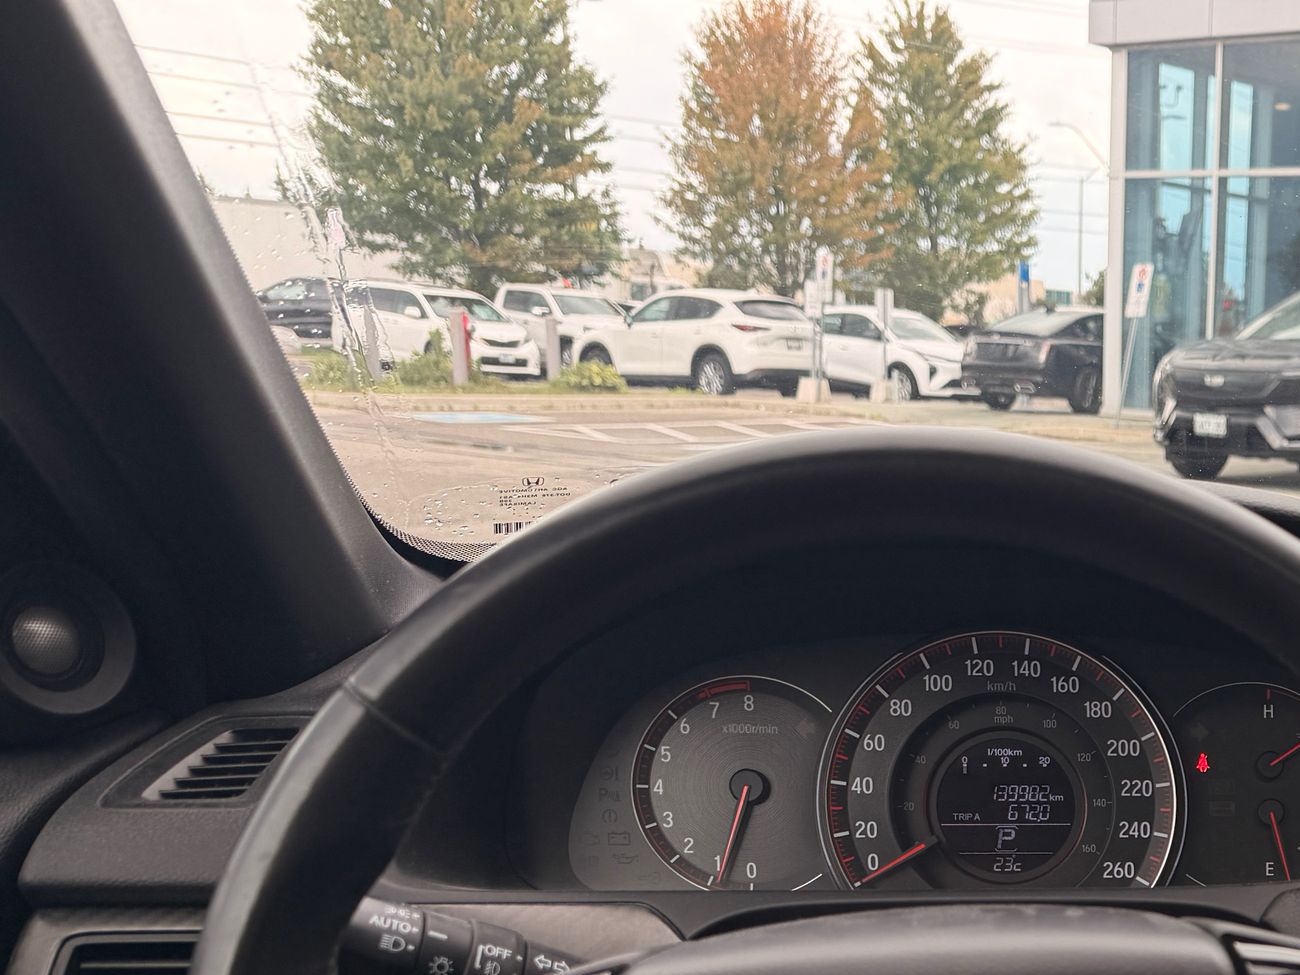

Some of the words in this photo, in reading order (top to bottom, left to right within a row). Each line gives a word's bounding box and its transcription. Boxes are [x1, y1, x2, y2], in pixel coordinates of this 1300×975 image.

[964, 660, 994, 677] 120
[1012, 660, 1041, 678] 140
[923, 675, 952, 692] 100
[986, 680, 1016, 692] km/h
[1050, 676, 1080, 694] 160
[709, 702, 720, 719] 7
[744, 695, 754, 712] 8
[889, 699, 913, 718] 80
[1084, 702, 1112, 719] 180
[1264, 704, 1274, 718] H
[680, 718, 690, 734] 6
[994, 714, 1014, 725] mph
[863, 734, 886, 752] 60
[1106, 740, 1141, 758] 200
[660, 746, 672, 762] 5
[962, 756, 968, 764] 0
[1000, 756, 1010, 764] 10
[1038, 756, 1050, 764] 20
[653, 779, 664, 795] 4
[851, 777, 874, 794] 40
[1120, 780, 1152, 798] 220
[662, 812, 674, 828] 3
[952, 813, 972, 821] TRIP
[973, 813, 981, 821] A
[854, 822, 878, 839] 20
[1118, 822, 1151, 840] 240
[684, 838, 694, 854] 2
[997, 829, 1016, 850] P
[714, 855, 721, 872] 1
[746, 862, 757, 879] 0
[867, 854, 879, 871] 0
[1102, 862, 1135, 879] 260
[1265, 862, 1275, 876] E
[369, 914, 412, 934] AUTO
[484, 944, 513, 960] OFF
